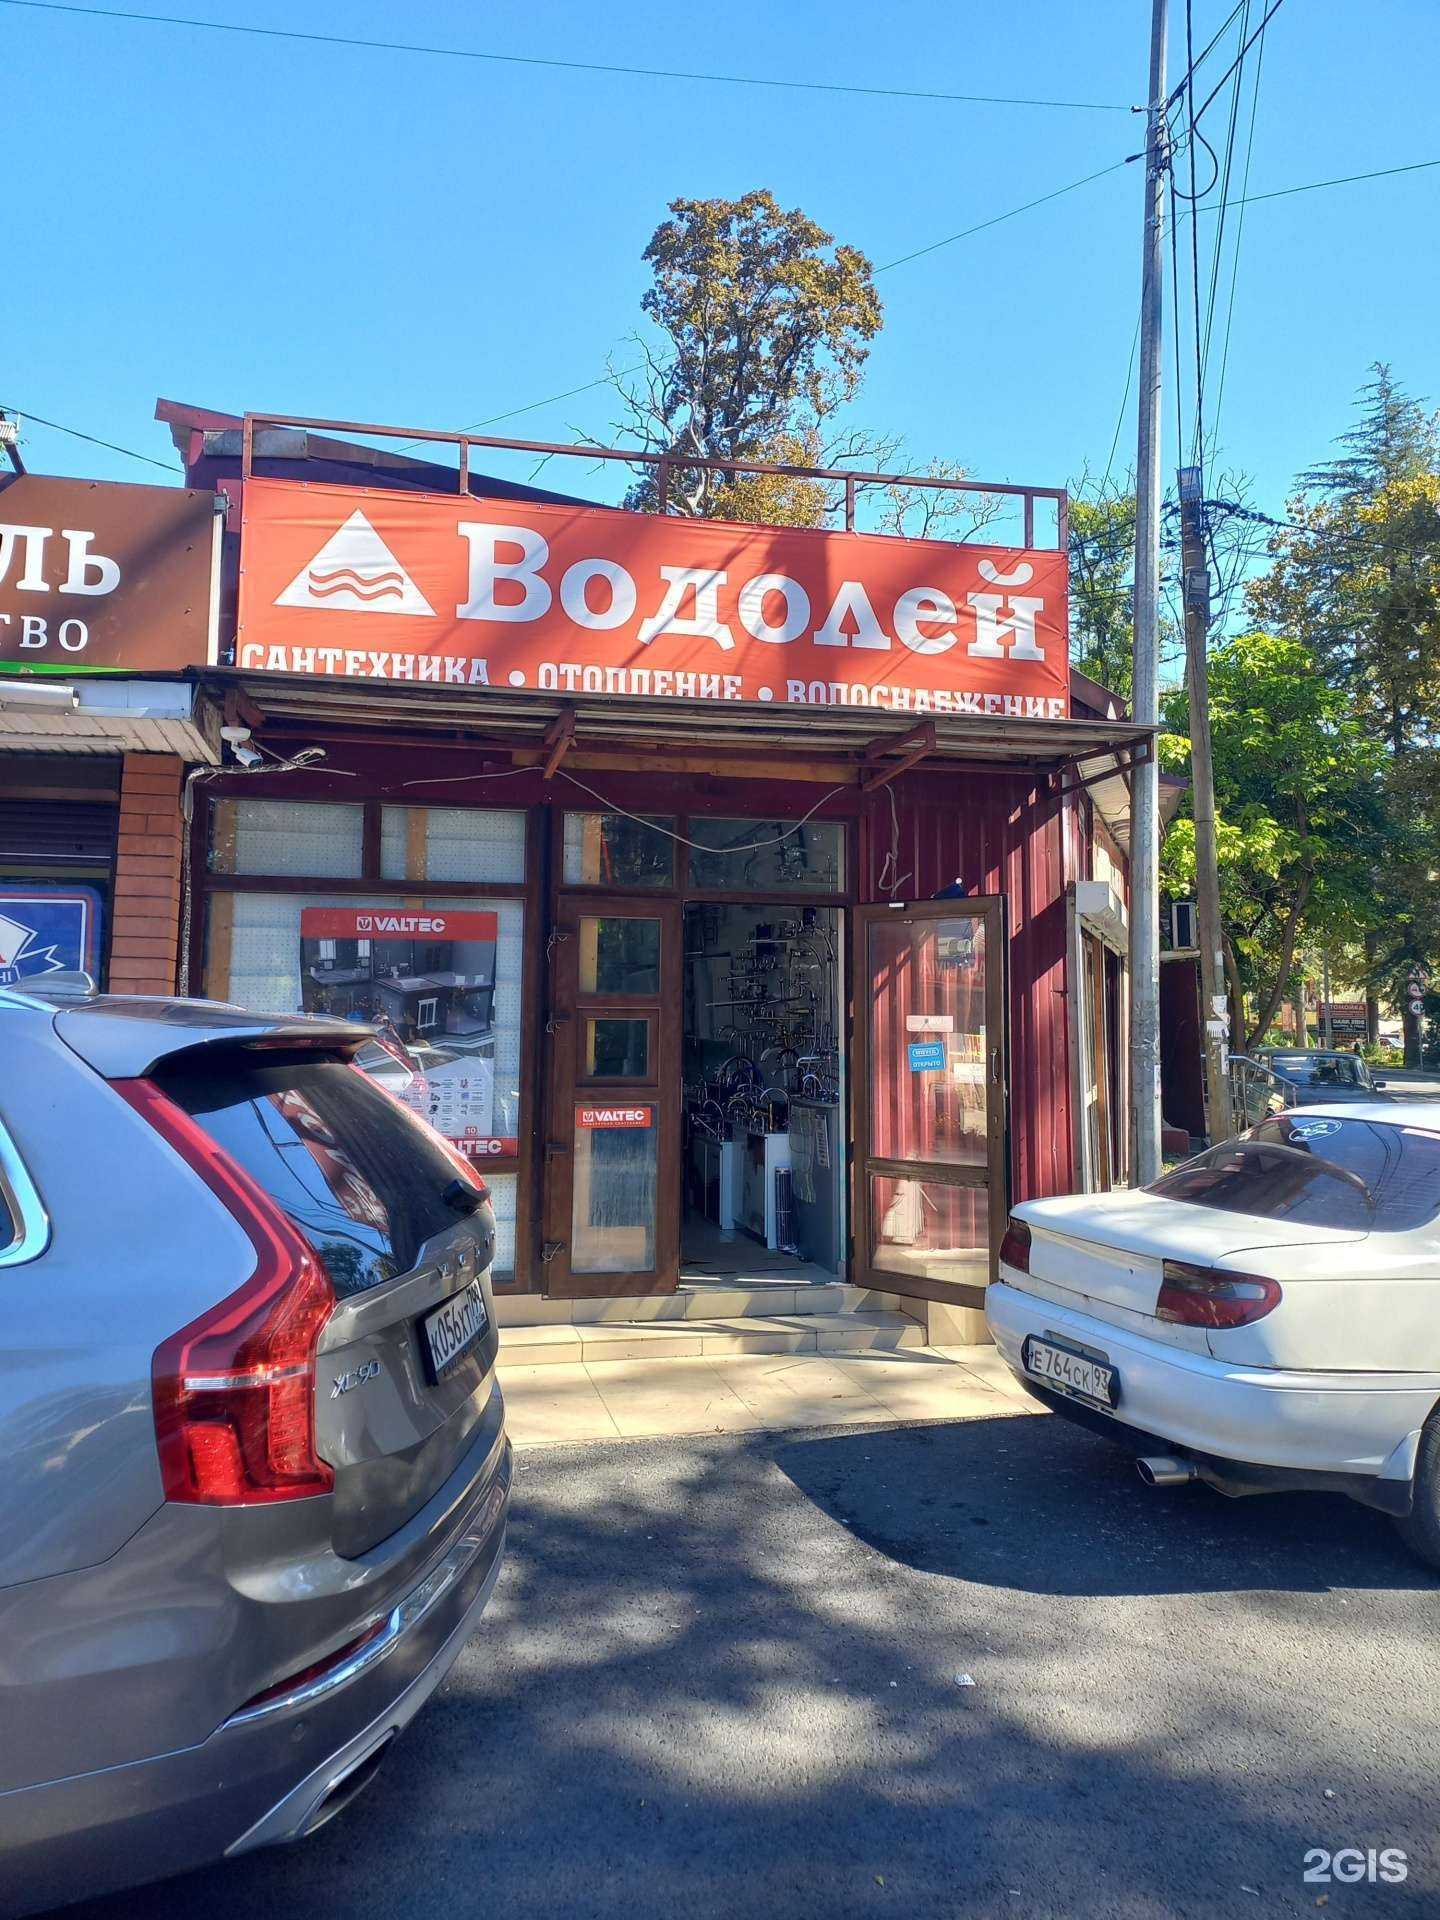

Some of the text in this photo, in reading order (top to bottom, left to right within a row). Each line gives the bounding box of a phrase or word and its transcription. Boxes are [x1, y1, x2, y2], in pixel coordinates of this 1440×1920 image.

[456, 520, 1046, 662] Водолей
[241, 643, 490, 686] САНТЕХНИКА
[373, 916, 447, 933] VALTEC
[594, 1110, 646, 1122] VALTEC
[330, 1361, 380, 1399] XC90
[1093, 1367, 1108, 1390] 93
